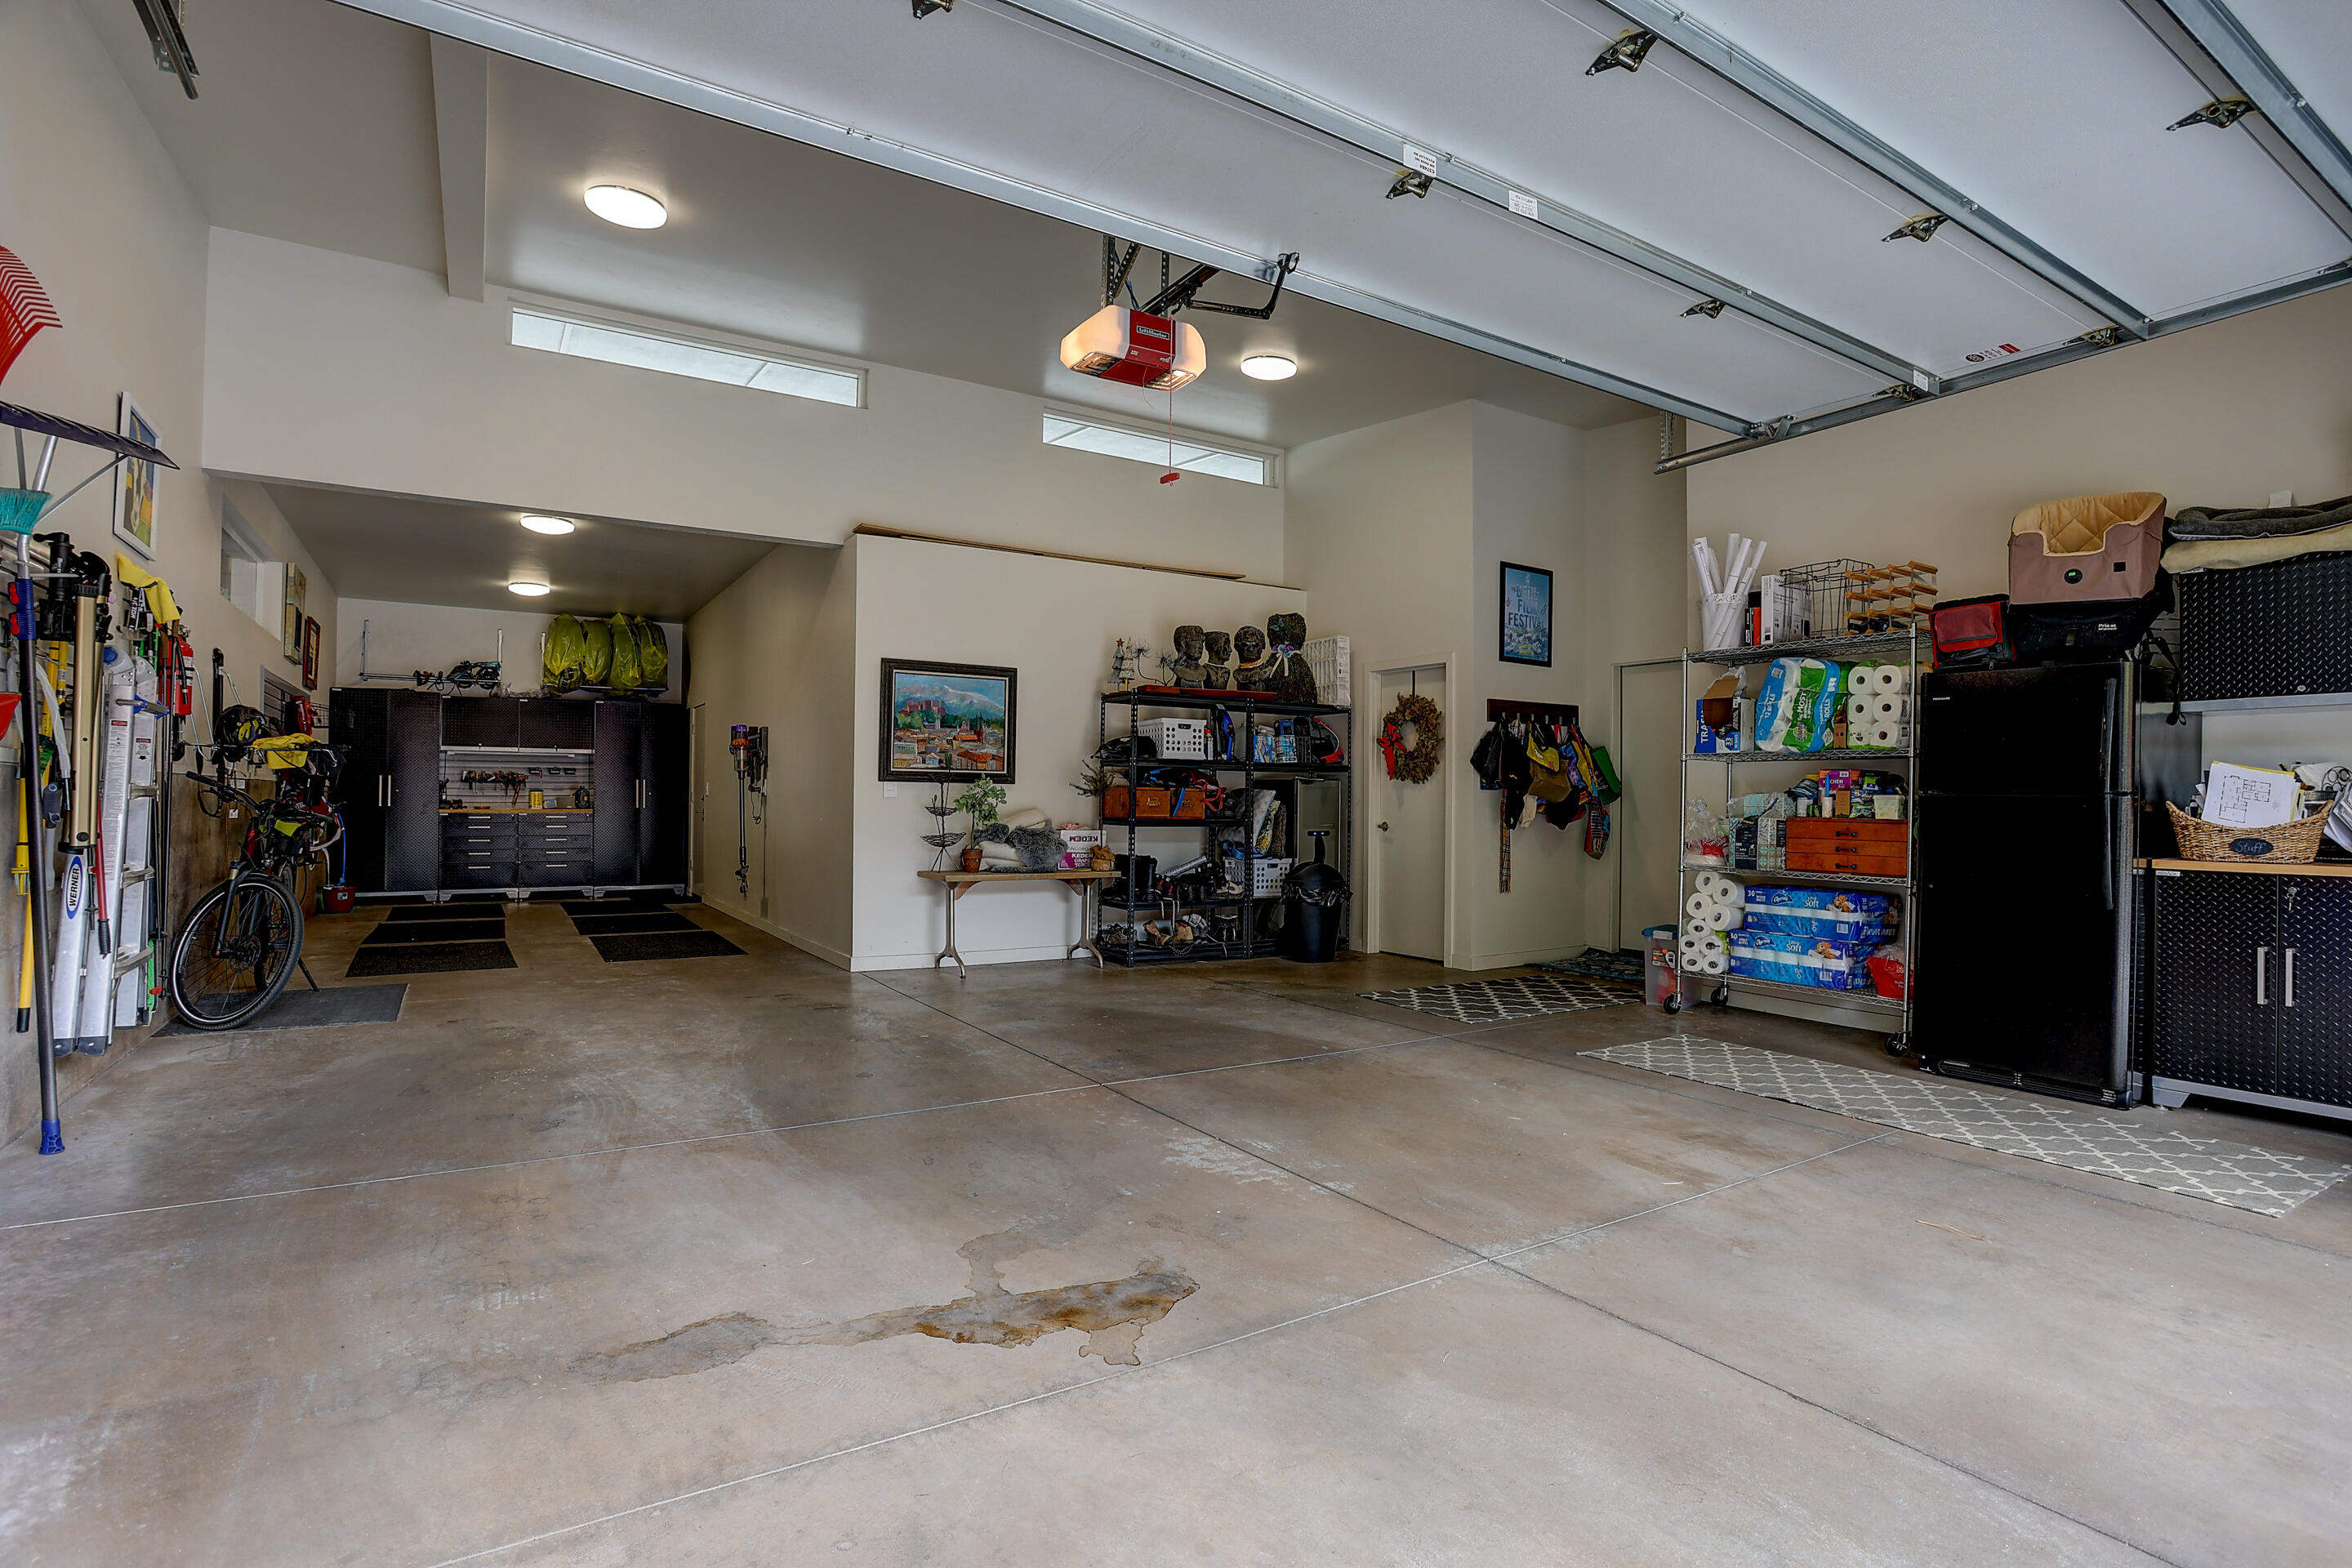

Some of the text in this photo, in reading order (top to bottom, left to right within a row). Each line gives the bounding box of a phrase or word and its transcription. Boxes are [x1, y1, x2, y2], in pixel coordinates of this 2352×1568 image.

[1139, 327, 1167, 338] LiftMaster
[1517, 599, 1539, 615] FILM
[1767, 693, 1775, 711] ROLLS
[1797, 691, 1806, 713] MOST
[1725, 737, 1732, 746] 33
[2234, 841, 2266, 853] Stuff
[69, 867, 80, 906] WERNER
[1804, 900, 1820, 908] Soft
[1785, 944, 1802, 952] Soft
